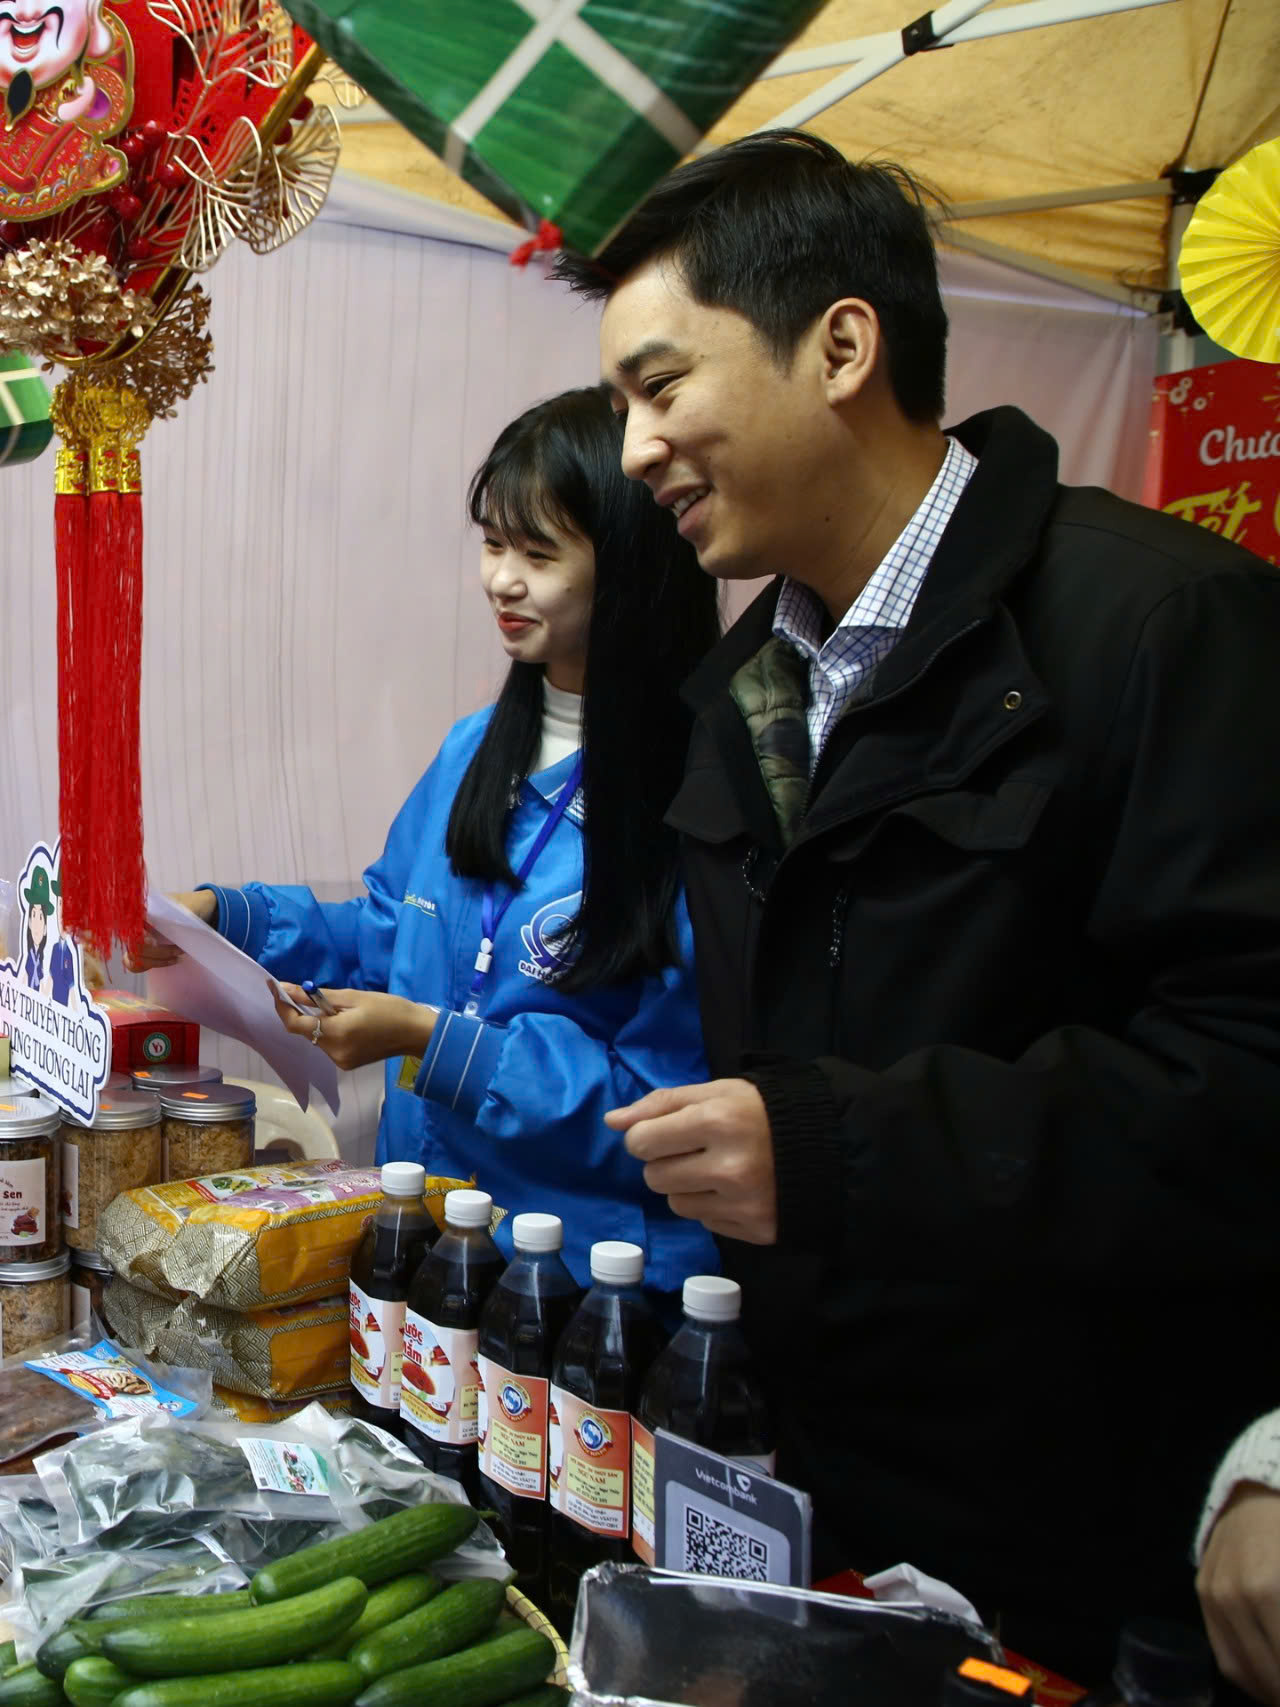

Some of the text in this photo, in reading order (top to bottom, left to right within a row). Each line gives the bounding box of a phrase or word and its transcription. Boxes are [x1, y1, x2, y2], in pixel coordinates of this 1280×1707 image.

[20, 992, 61, 1039] TRUYỀN
[62, 1015, 101, 1063] THỐNG
[71, 1062, 90, 1100] LAI
[3, 1190, 23, 1199] Sen
[404, 1322, 423, 1343] ước
[695, 1468, 757, 1505] Vietcombank
